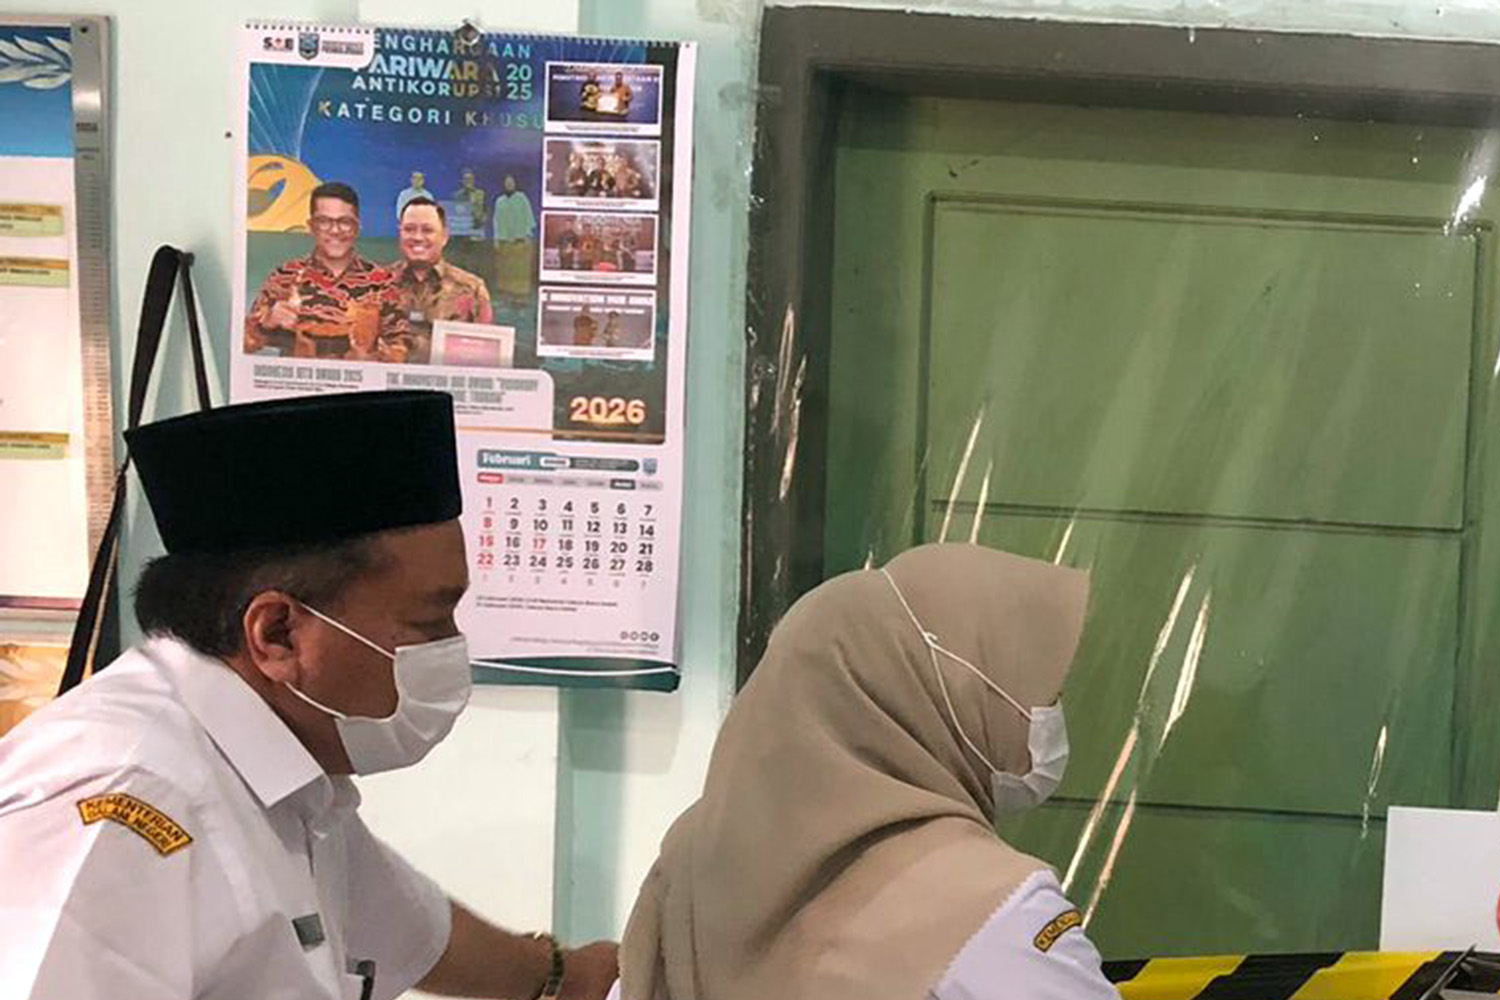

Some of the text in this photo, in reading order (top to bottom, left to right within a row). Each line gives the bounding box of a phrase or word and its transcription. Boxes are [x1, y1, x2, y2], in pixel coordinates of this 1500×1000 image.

[374, 33, 531, 59] ENGHARGAAN
[354, 53, 532, 83] ARIWARA 20
[506, 81, 532, 100] 25
[318, 100, 544, 129] KATEGORI KHUSU
[570, 396, 646, 424] 2026
[483, 452, 531, 466] Februari
[487, 496, 653, 516] 1 2 3 4 5 6 7
[483, 516, 654, 537] 8 9 10 11 12 13 14
[479, 535, 653, 555] 15 16 17 18 19 20 21
[477, 553, 653, 573] 22 23 24 25 26 27 28
